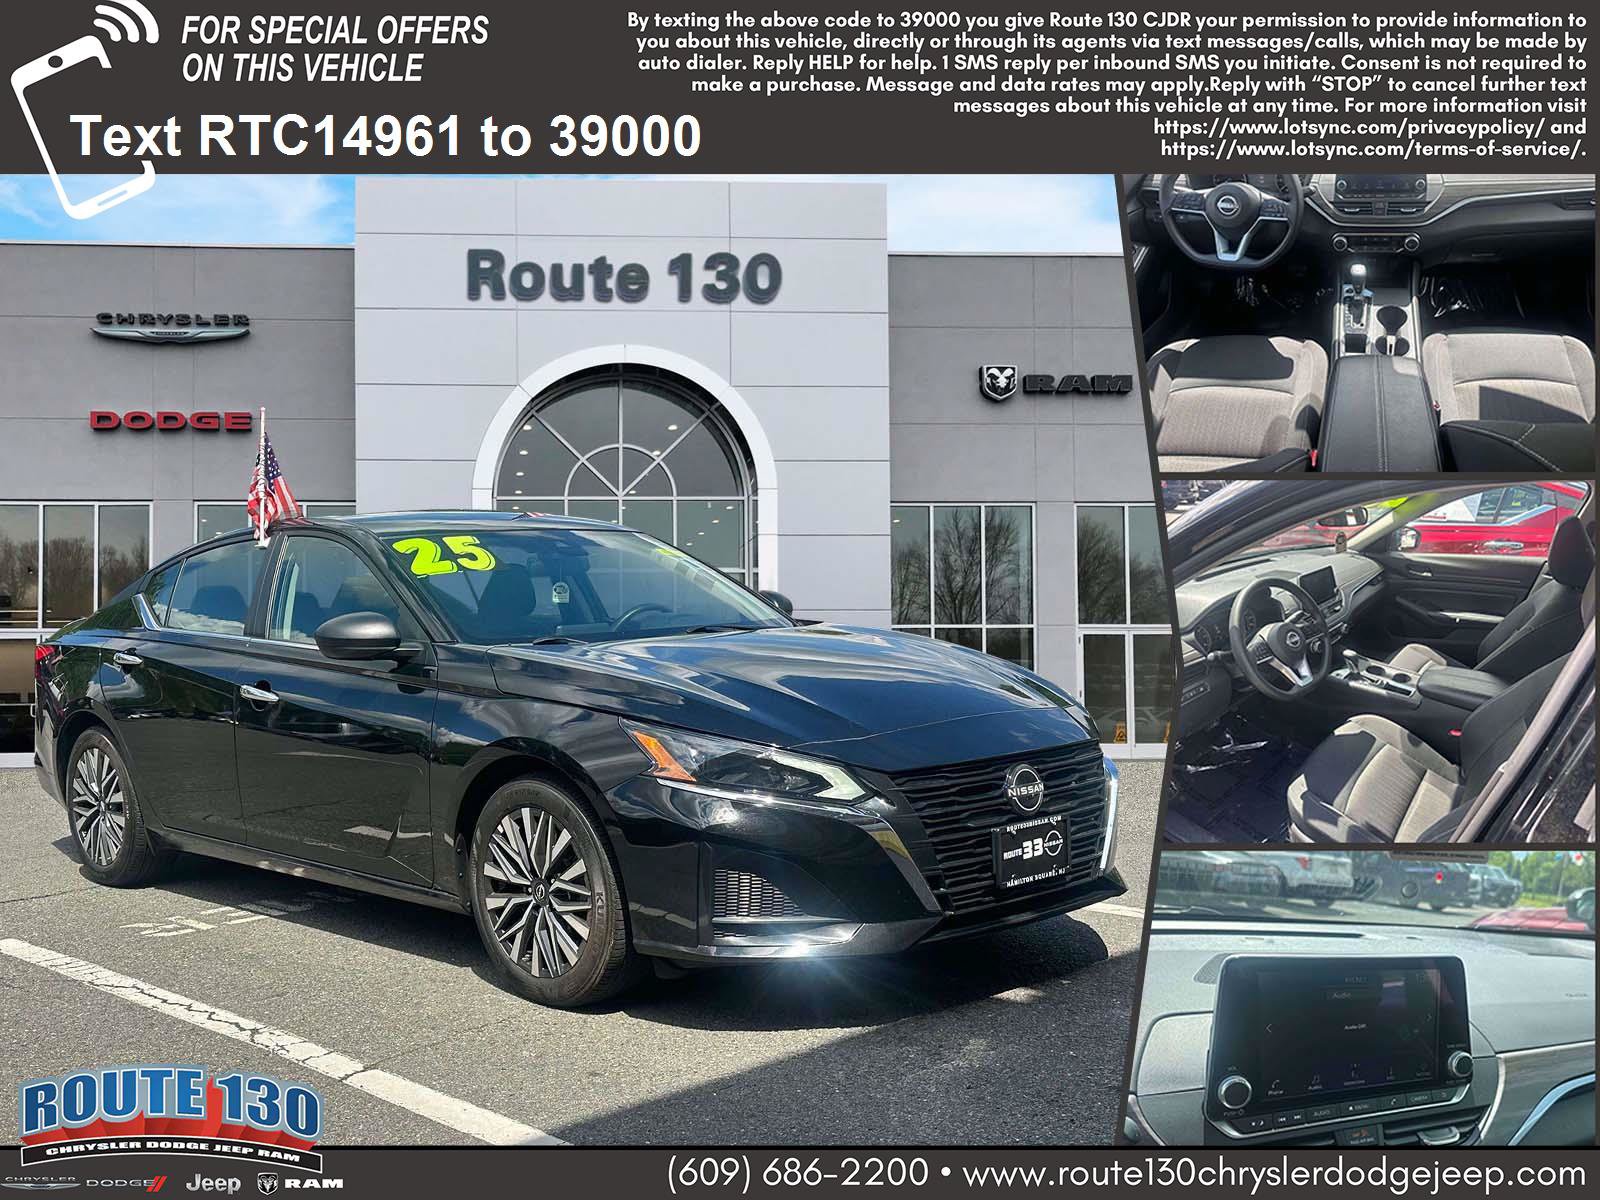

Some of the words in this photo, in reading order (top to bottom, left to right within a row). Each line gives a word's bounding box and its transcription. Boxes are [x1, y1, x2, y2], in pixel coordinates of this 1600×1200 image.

[467, 249, 650, 302] Route
[668, 252, 782, 304] 130
[96, 312, 250, 326] CHRYSLER
[1022, 375, 1133, 393] RAM
[90, 411, 252, 432] DODGE
[392, 536, 496, 578] 25
[1008, 782, 1044, 797] NISSAN
[1003, 848, 1022, 860] ROUTE
[1023, 837, 1043, 859] 33
[1044, 839, 1063, 848] NISSAN
[1006, 876, 1034, 887] HAMILTON
